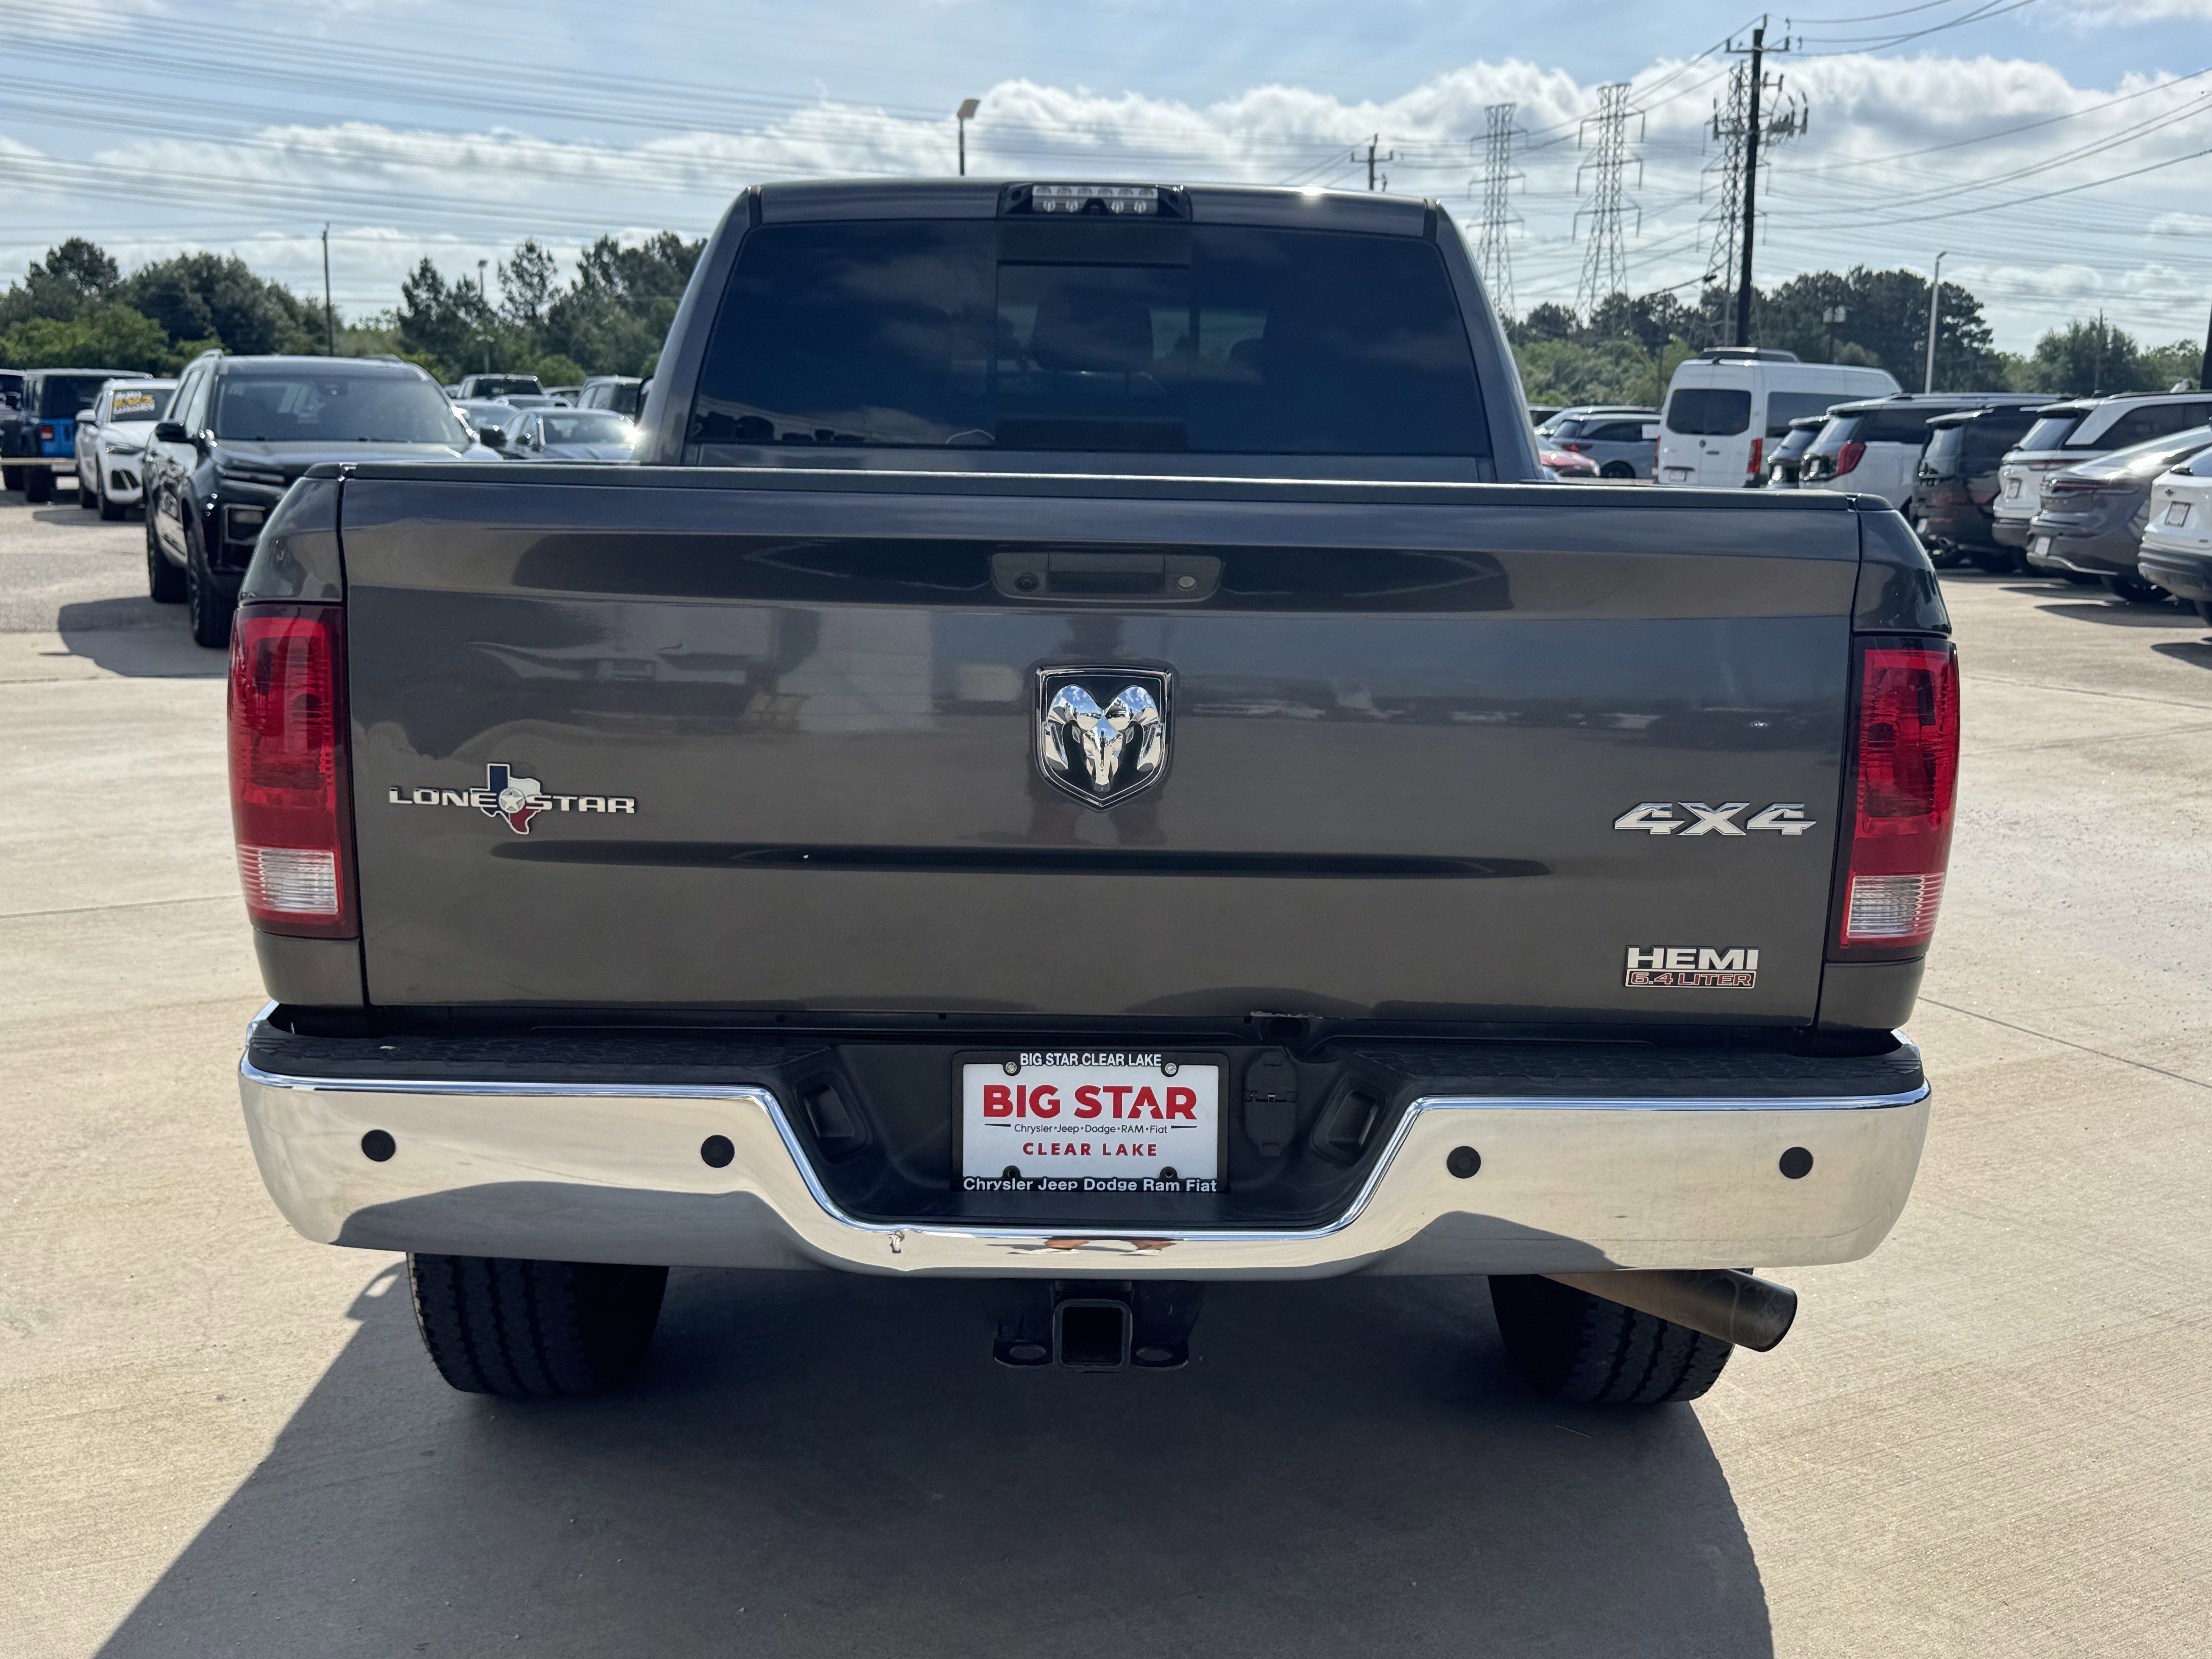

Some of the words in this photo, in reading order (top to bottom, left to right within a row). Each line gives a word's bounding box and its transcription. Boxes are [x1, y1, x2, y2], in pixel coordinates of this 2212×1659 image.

[389, 786, 498, 807] LONE
[526, 795, 635, 813] STAR
[1614, 802, 1817, 835] 4X4
[1627, 947, 1759, 970] HEMI
[1631, 973, 1673, 985] 6.4
[1678, 973, 1751, 986] LITER
[1020, 1053, 1042, 1066] BIG
[1046, 1053, 1079, 1066] STAR
[1082, 1054, 1124, 1066] CLEAR
[1128, 1054, 1161, 1066] LAKE
[983, 1085, 1061, 1118] BIG
[1074, 1085, 1197, 1120] STAR
[1014, 1123, 1053, 1134] Chrysler
[1057, 1124, 1079, 1134] Jeep
[1085, 1124, 1116, 1134] Dodge
[1122, 1125, 1144, 1133] RAM
[1150, 1125, 1168, 1134] Fiat
[1023, 1142, 1091, 1156] CLEAR
[1103, 1144, 1157, 1156] LAKE
[963, 1178, 1032, 1191] Chrysler
[1038, 1178, 1078, 1191] Jeep
[1085, 1179, 1137, 1192] Dodge
[1144, 1180, 1180, 1192] Ram
[1187, 1179, 1217, 1192] Fiat
